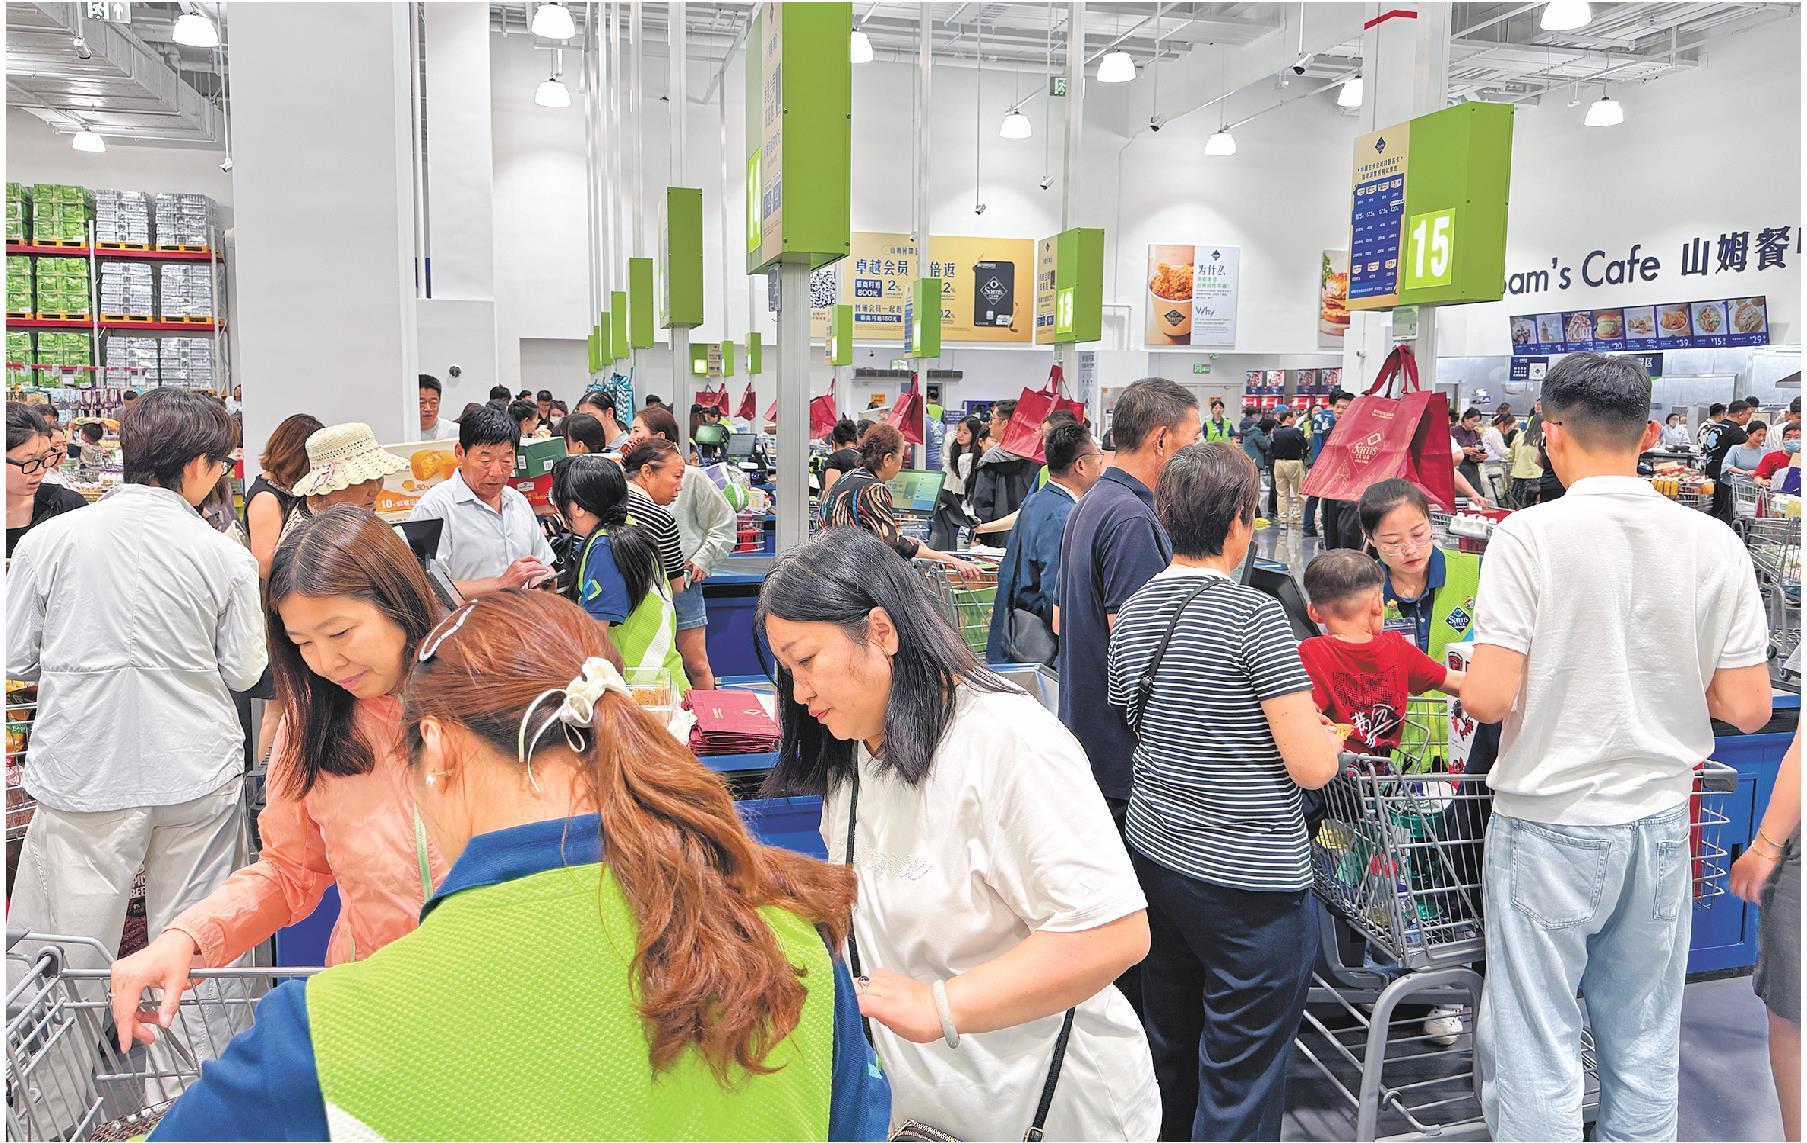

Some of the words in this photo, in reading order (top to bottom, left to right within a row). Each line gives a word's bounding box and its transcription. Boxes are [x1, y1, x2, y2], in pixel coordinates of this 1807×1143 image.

[1413, 215, 1450, 278] 15
[1680, 225, 1802, 277] 山姆餐
[855, 258, 909, 276] 卓越会员
[1198, 264, 1226, 276] 为什么
[1502, 257, 1571, 295] am's
[1581, 244, 1661, 288] Cafe
[1058, 291, 1073, 328] 13
[1195, 305, 1215, 318] Why
